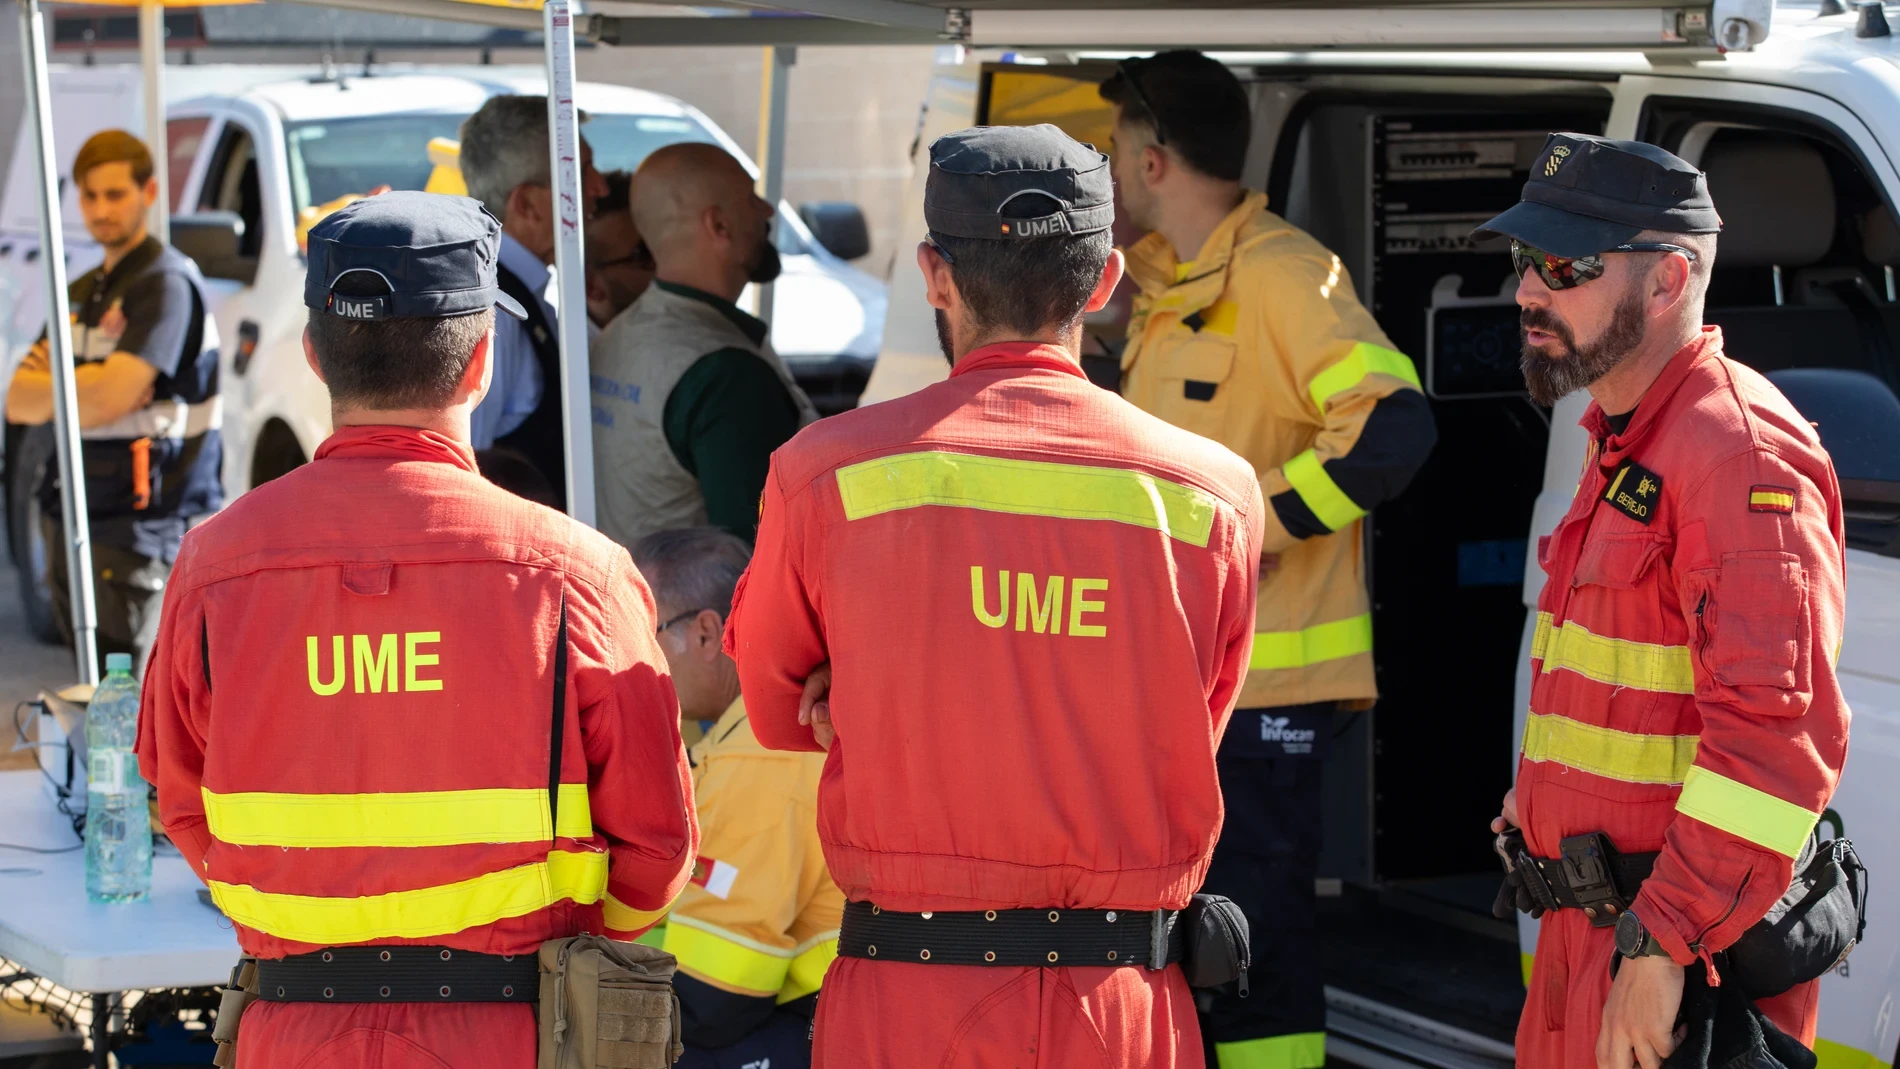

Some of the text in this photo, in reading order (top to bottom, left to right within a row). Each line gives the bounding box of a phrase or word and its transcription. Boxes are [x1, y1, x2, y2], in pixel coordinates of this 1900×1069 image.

[1016, 219, 1060, 236] UME
[335, 300, 374, 318] UME
[970, 565, 1109, 637] UME
[306, 631, 444, 696] UME
